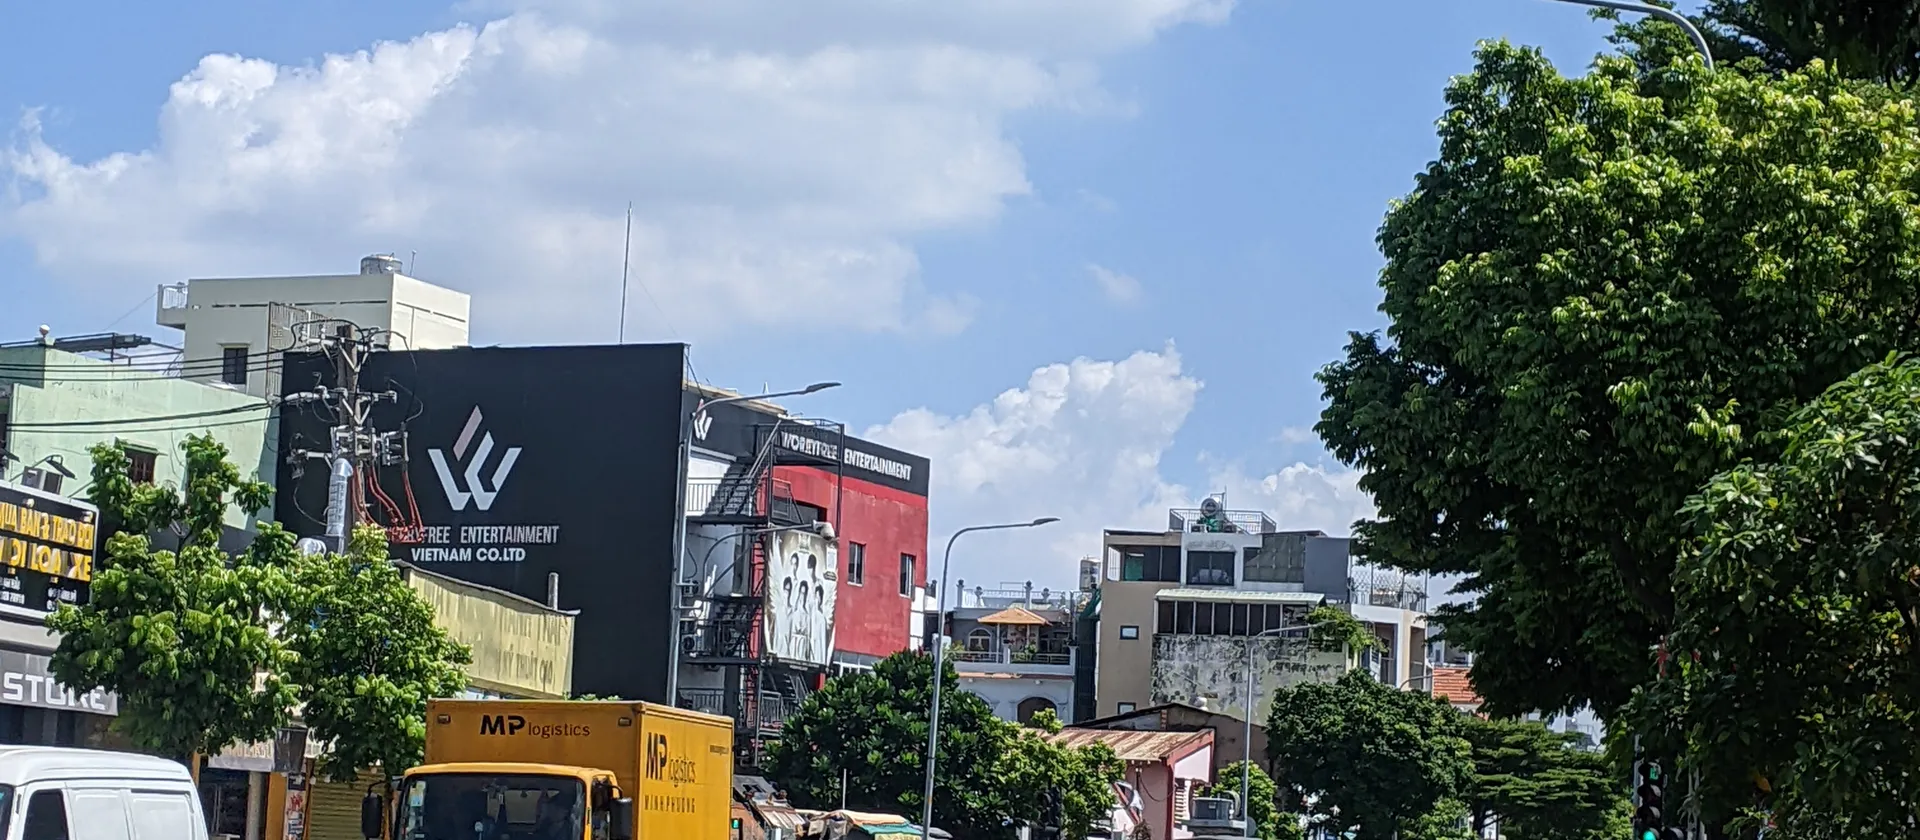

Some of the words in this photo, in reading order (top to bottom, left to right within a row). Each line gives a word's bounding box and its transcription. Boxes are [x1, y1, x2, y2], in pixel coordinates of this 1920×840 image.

[844, 448, 912, 481] ENTERTAINMENT
[461, 526, 560, 544] ENTERTAINMENT
[69, 551, 92, 582] XE
[411, 548, 472, 561] VIETNAM
[476, 548, 526, 561] CO.LTD
[480, 714, 526, 736] MP
[528, 721, 591, 740] logistics
[646, 732, 668, 781] MP
